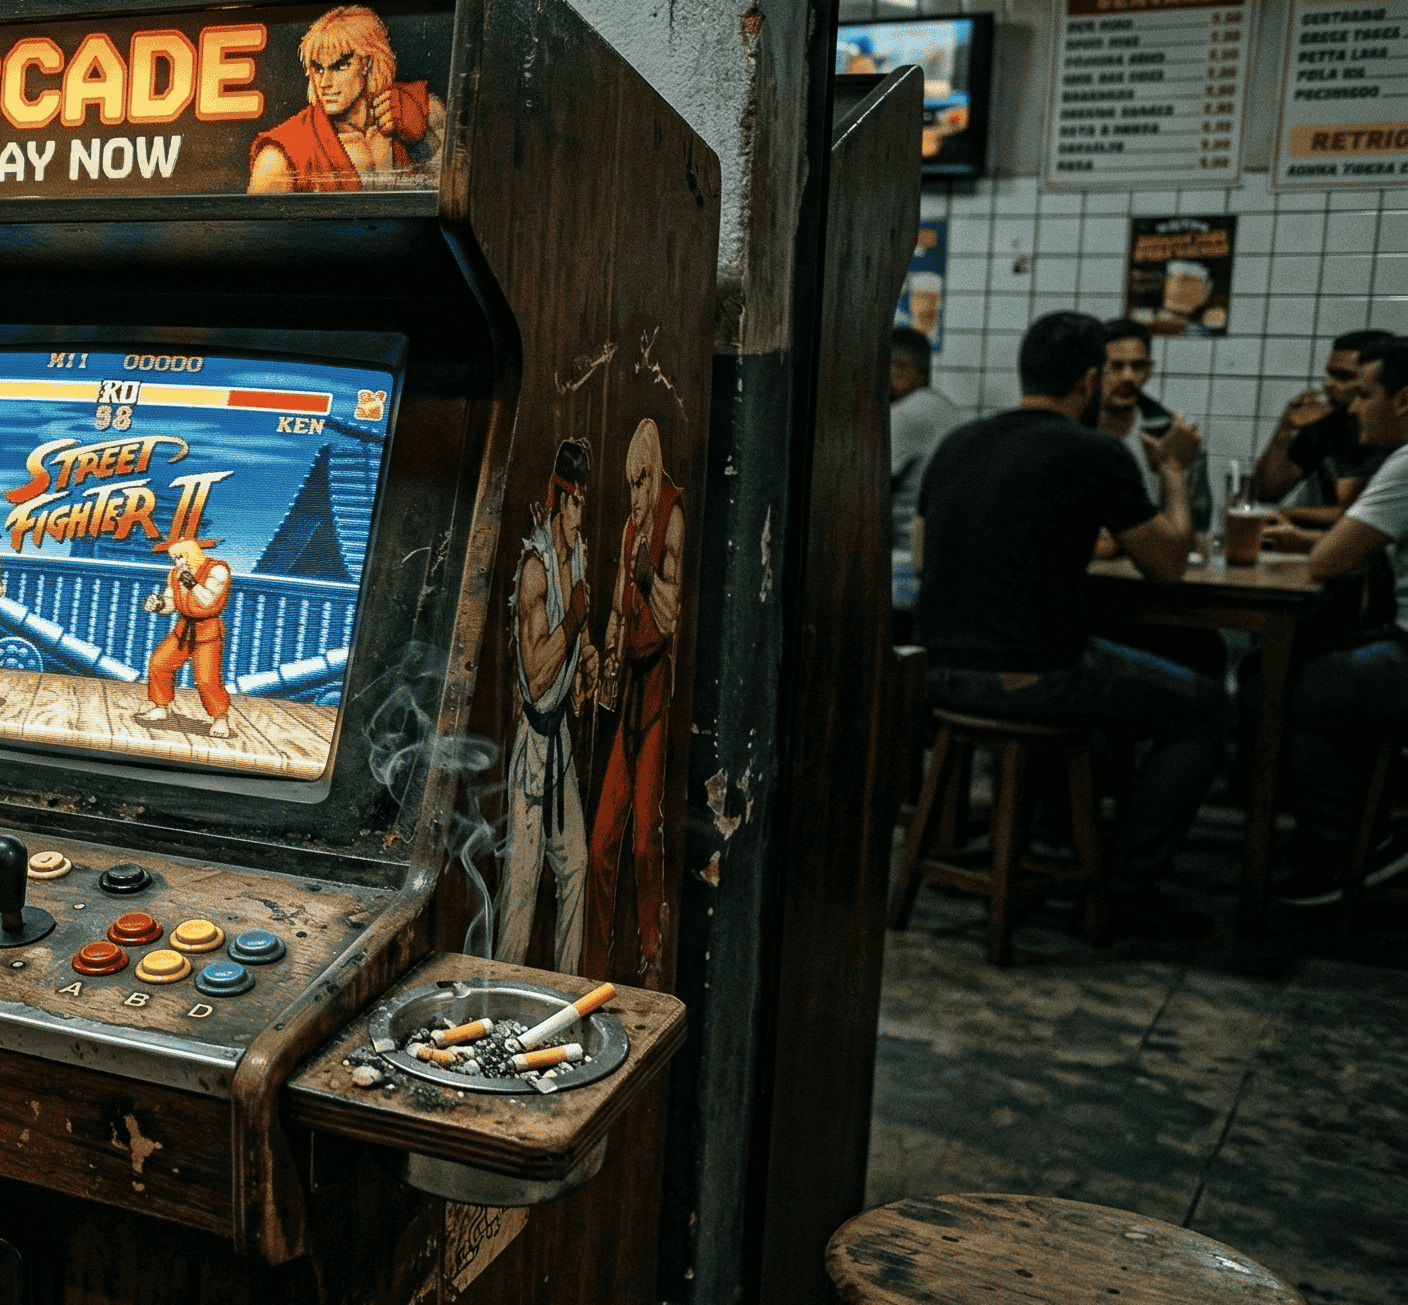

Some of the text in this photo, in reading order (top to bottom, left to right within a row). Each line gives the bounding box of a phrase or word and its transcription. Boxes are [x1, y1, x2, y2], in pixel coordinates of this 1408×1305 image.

[69, 135, 182, 180] NOW
[94, 405, 133, 431] 98
[276, 416, 325, 434] KEN
[4, 435, 190, 504] STREET
[5, 469, 235, 552] FIGHTER II
[58, 981, 214, 1018] A B D
